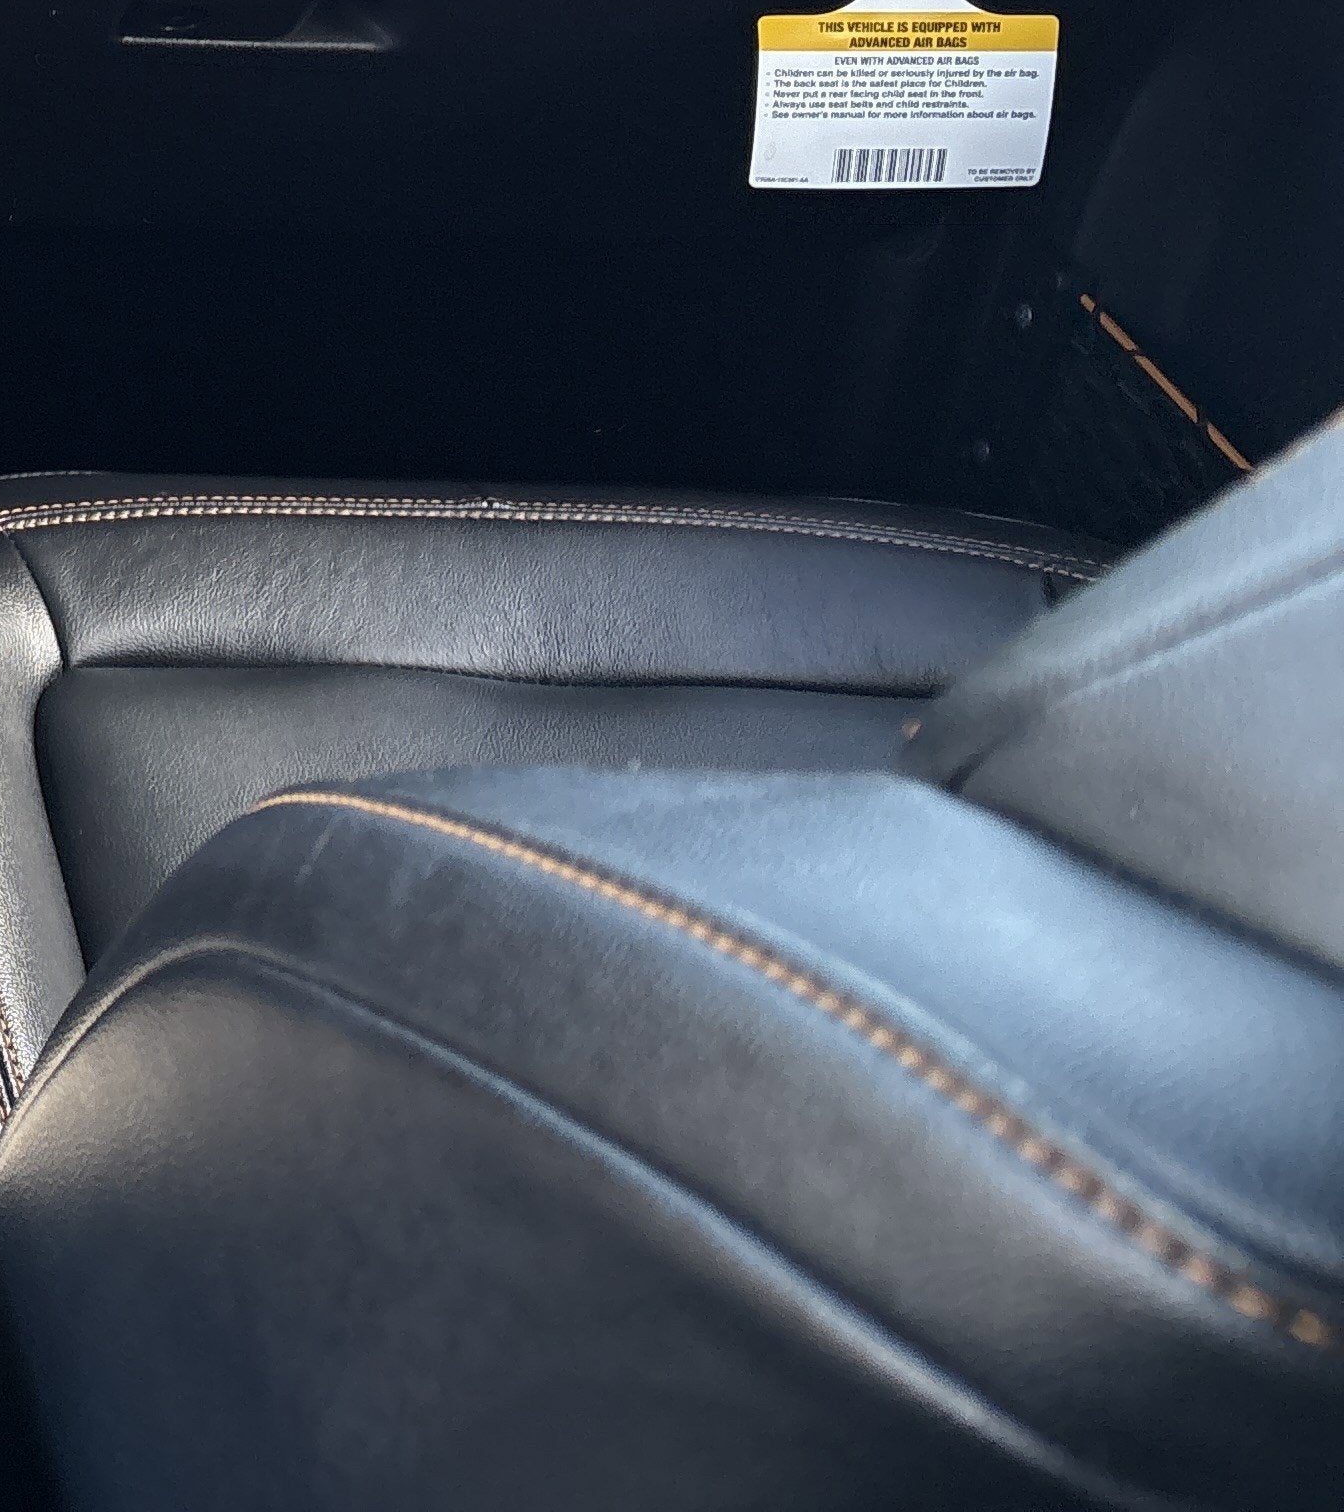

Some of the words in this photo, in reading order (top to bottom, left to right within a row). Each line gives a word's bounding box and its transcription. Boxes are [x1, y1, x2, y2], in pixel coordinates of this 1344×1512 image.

[818, 21, 845, 33] THIS
[847, 21, 894, 33] VEHICLE
[897, 21, 909, 33] IS
[912, 21, 968, 33] EQUIPPED
[971, 21, 1002, 33] WITH
[849, 36, 911, 48] ADVANCED
[913, 36, 933, 48] AIR
[936, 36, 968, 48] BAGS
[834, 56, 858, 66] EVEN
[860, 56, 884, 66] WITH
[886, 56, 934, 66] ADVANCED
[937, 56, 953, 66] AIR
[955, 56, 980, 66] BAGS
[774, 69, 815, 78] Children
[816, 69, 834, 78] can
[850, 69, 876, 78] killed
[890, 69, 934, 80] seriously
[937, 69, 970, 80] injured
[986, 69, 1002, 78] the
[1004, 69, 1017, 78] air
[1018, 69, 1039, 79] bag.
[774, 80, 792, 88] The
[793, 80, 817, 88] back
[819, 80, 839, 88] seat
[852, 80, 867, 88] the
[870, 80, 898, 88] safest
[900, 80, 926, 89] place
[928, 80, 942, 88] for
[944, 80, 987, 88] Children.
[772, 90, 800, 98] Never
[803, 90, 819, 99] put
[829, 90, 848, 98] rear
[850, 90, 880, 99] facing
[881, 90, 905, 98] child
[907, 90, 927, 98] seat
[941, 90, 957, 98] the
[959, 90, 984, 98] front.
[772, 100, 806, 109] Always
[809, 100, 826, 108] use
[828, 100, 848, 108] seat
[850, 100, 874, 108] belts
[876, 100, 893, 108] and
[895, 100, 919, 108] child
[922, 100, 969, 108] restraints.
[772, 110, 790, 119] See
[792, 110, 829, 119] owner's
[831, 110, 866, 119] manual
[867, 110, 881, 119] for
[883, 110, 908, 119] more
[911, 110, 965, 119] information
[967, 110, 994, 119] about
[996, 110, 1009, 119] air
[1011, 110, 1036, 120] bags.
